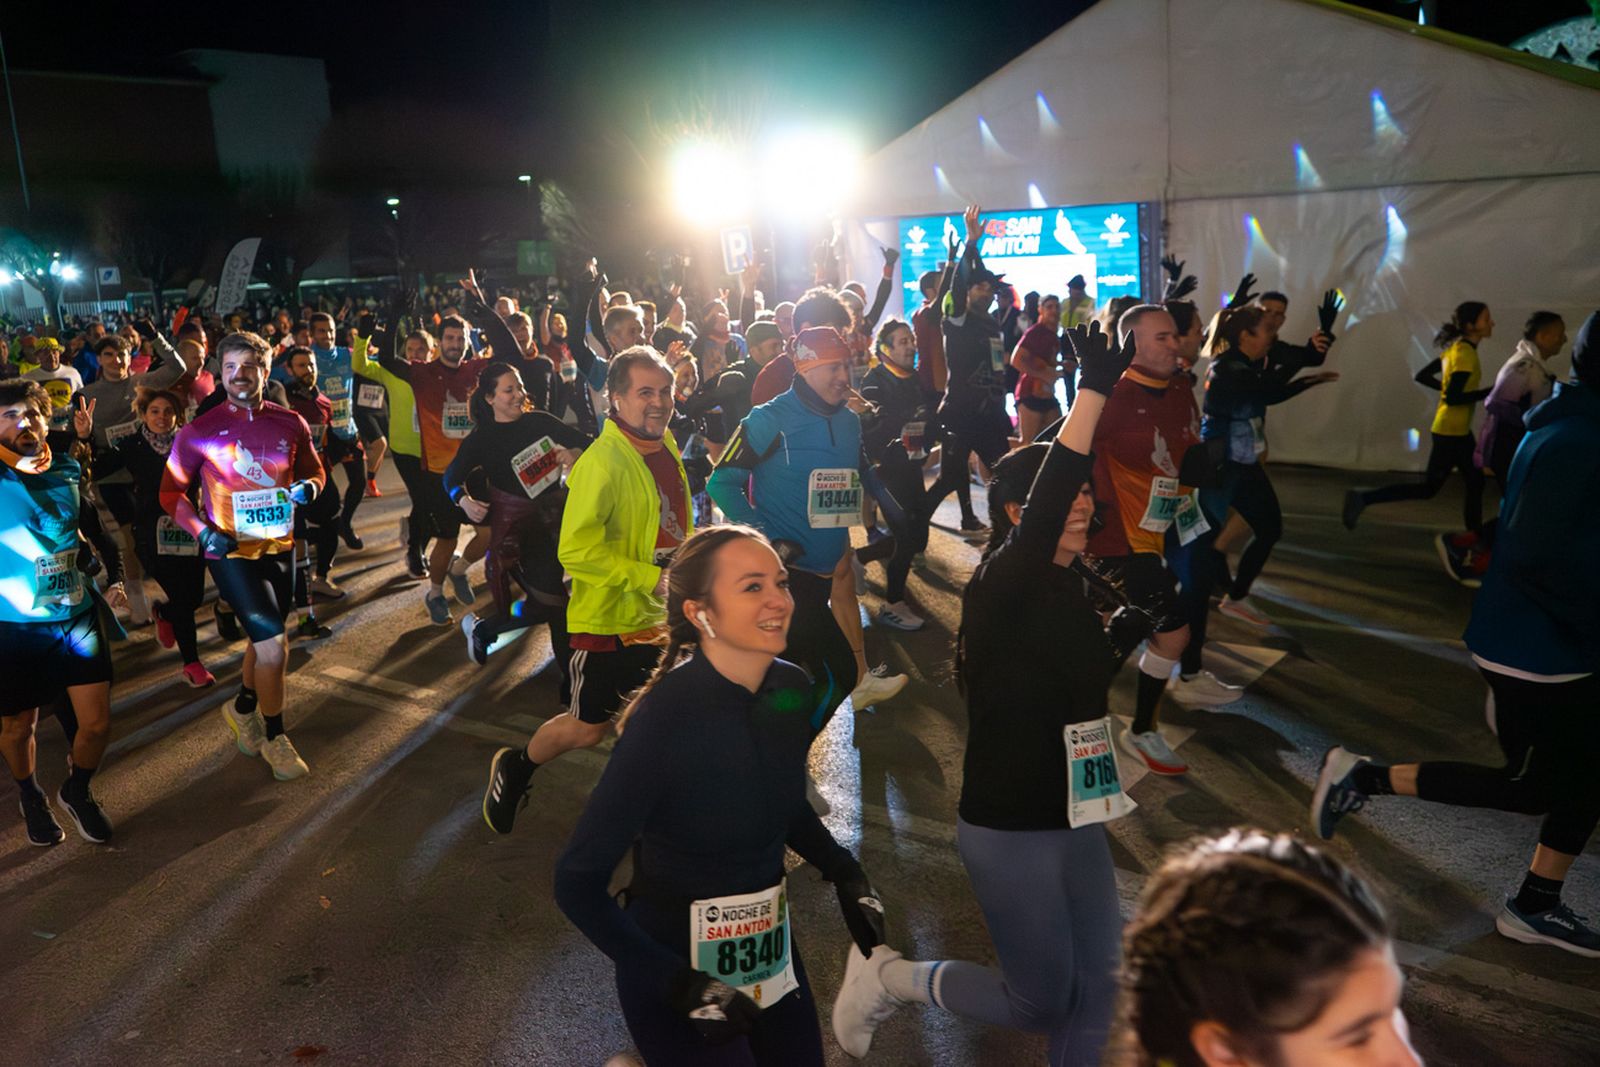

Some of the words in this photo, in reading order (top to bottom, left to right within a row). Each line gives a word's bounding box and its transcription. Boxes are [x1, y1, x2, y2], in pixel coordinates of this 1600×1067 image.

[1007, 216, 1043, 235] SAN
[728, 232, 747, 268] P
[246, 466, 262, 480] 43
[817, 490, 858, 508] 13444
[245, 506, 285, 524] 3633
[1073, 746, 1090, 759] SAN
[722, 906, 758, 922] NOCHE
[760, 903, 772, 916] DE
[706, 923, 733, 940] SAN
[717, 925, 784, 976] 8340
